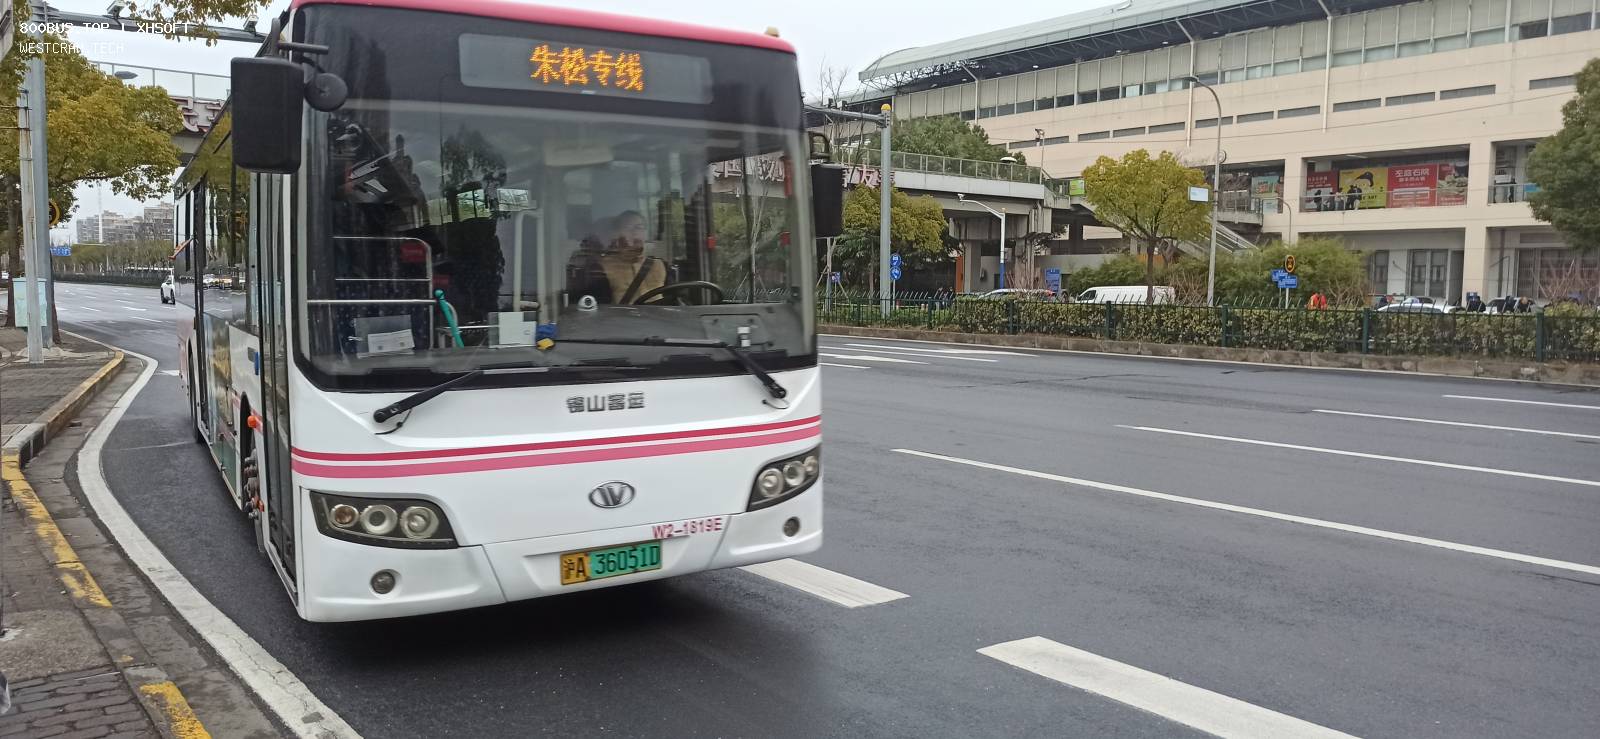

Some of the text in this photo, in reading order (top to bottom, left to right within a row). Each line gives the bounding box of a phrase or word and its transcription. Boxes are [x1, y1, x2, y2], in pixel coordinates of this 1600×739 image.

[530, 43, 645, 91] 朱松专线
[652, 517, 723, 540] W2-1819E
